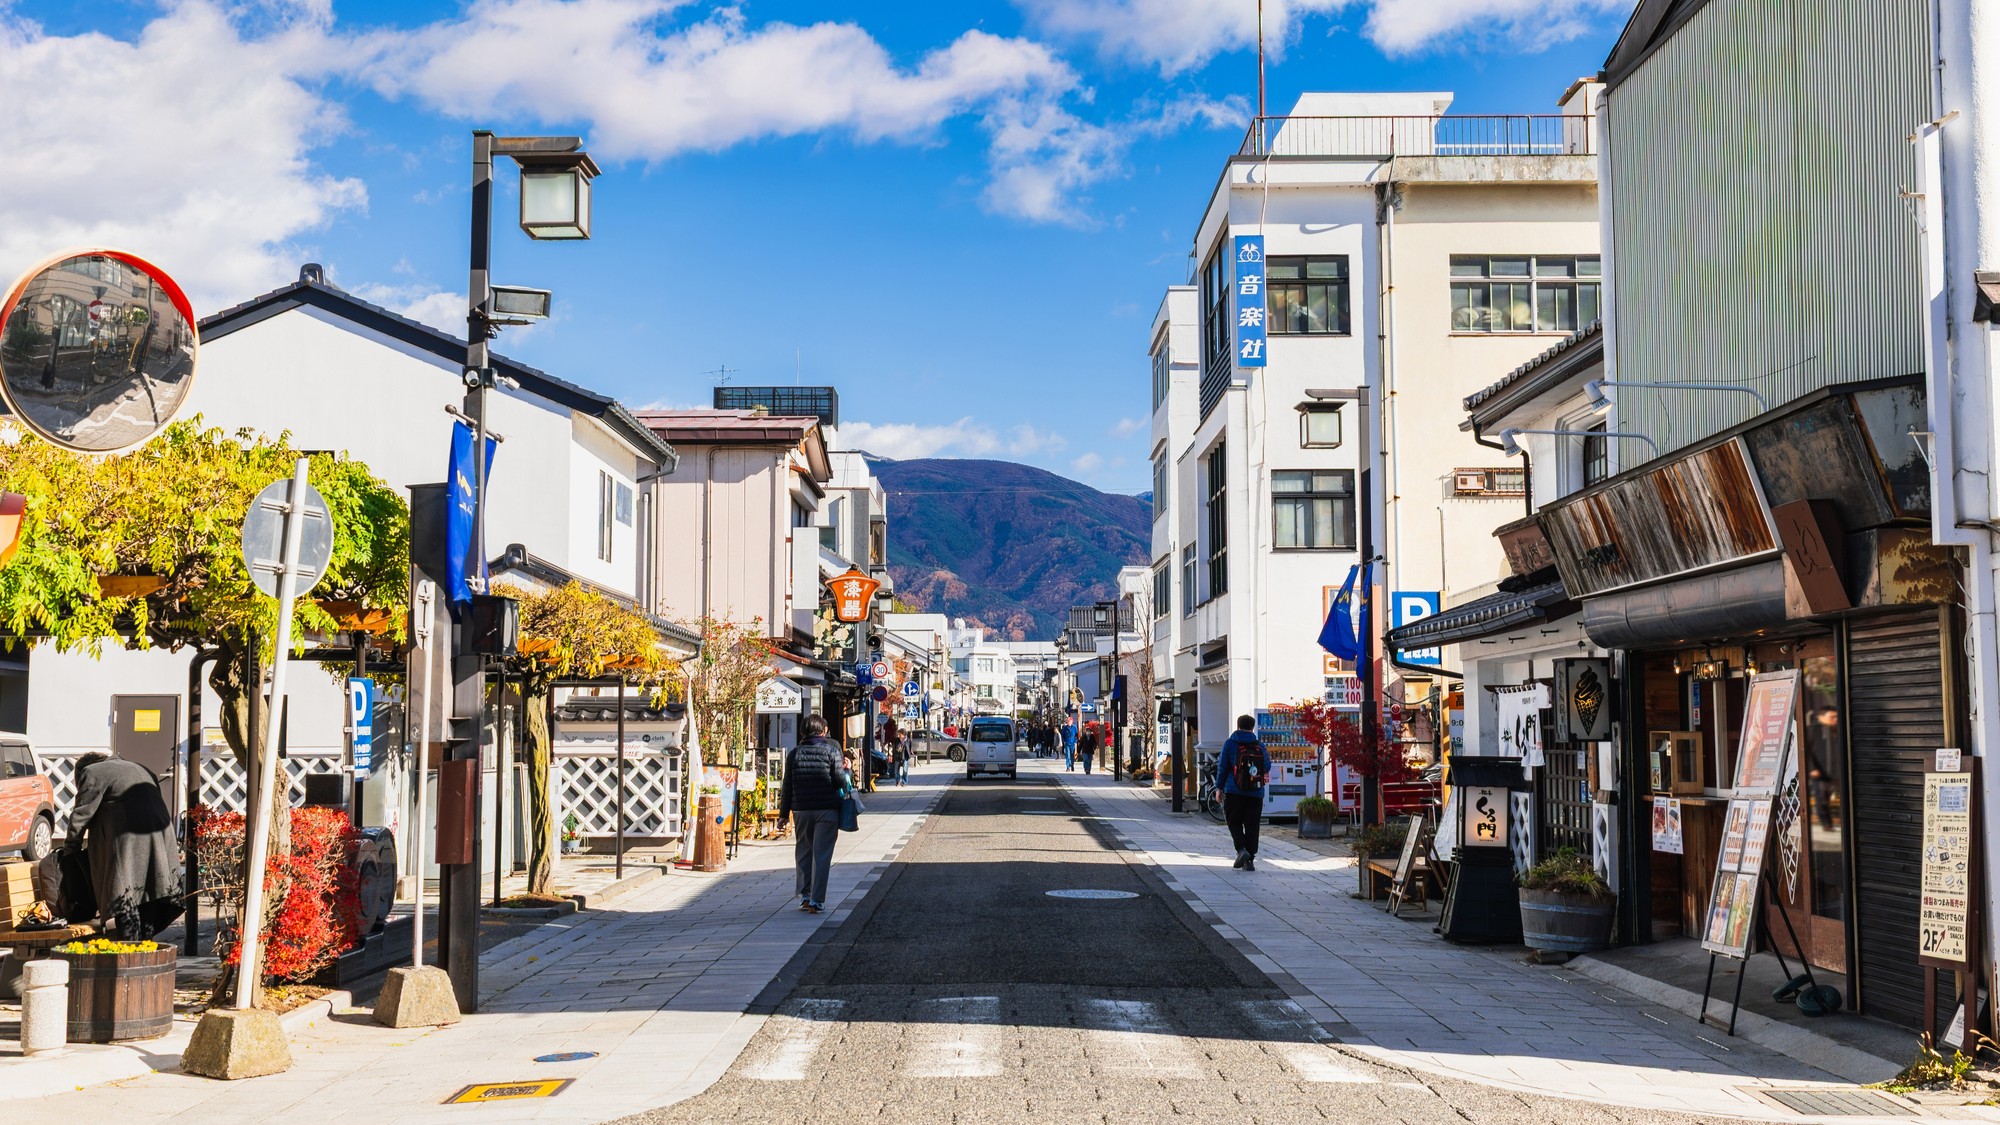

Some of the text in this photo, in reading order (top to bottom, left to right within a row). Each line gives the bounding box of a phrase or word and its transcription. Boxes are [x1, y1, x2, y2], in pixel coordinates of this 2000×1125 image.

[1238, 274, 1264, 359] 音楽社
[843, 579, 863, 617] 漆器
[1401, 597, 1432, 628] P
[876, 666, 885, 674] 30
[1692, 661, 1723, 680] TAKE OUT
[1345, 677, 1361, 690] 100
[1345, 691, 1361, 704] 100
[351, 681, 367, 741] P
[1159, 725, 1169, 745] 病院
[1476, 796, 1496, 838] くろ門
[1923, 928, 1938, 952] 2F
[1950, 932, 1965, 940] SNACKS
[1952, 947, 1963, 956] RUM
